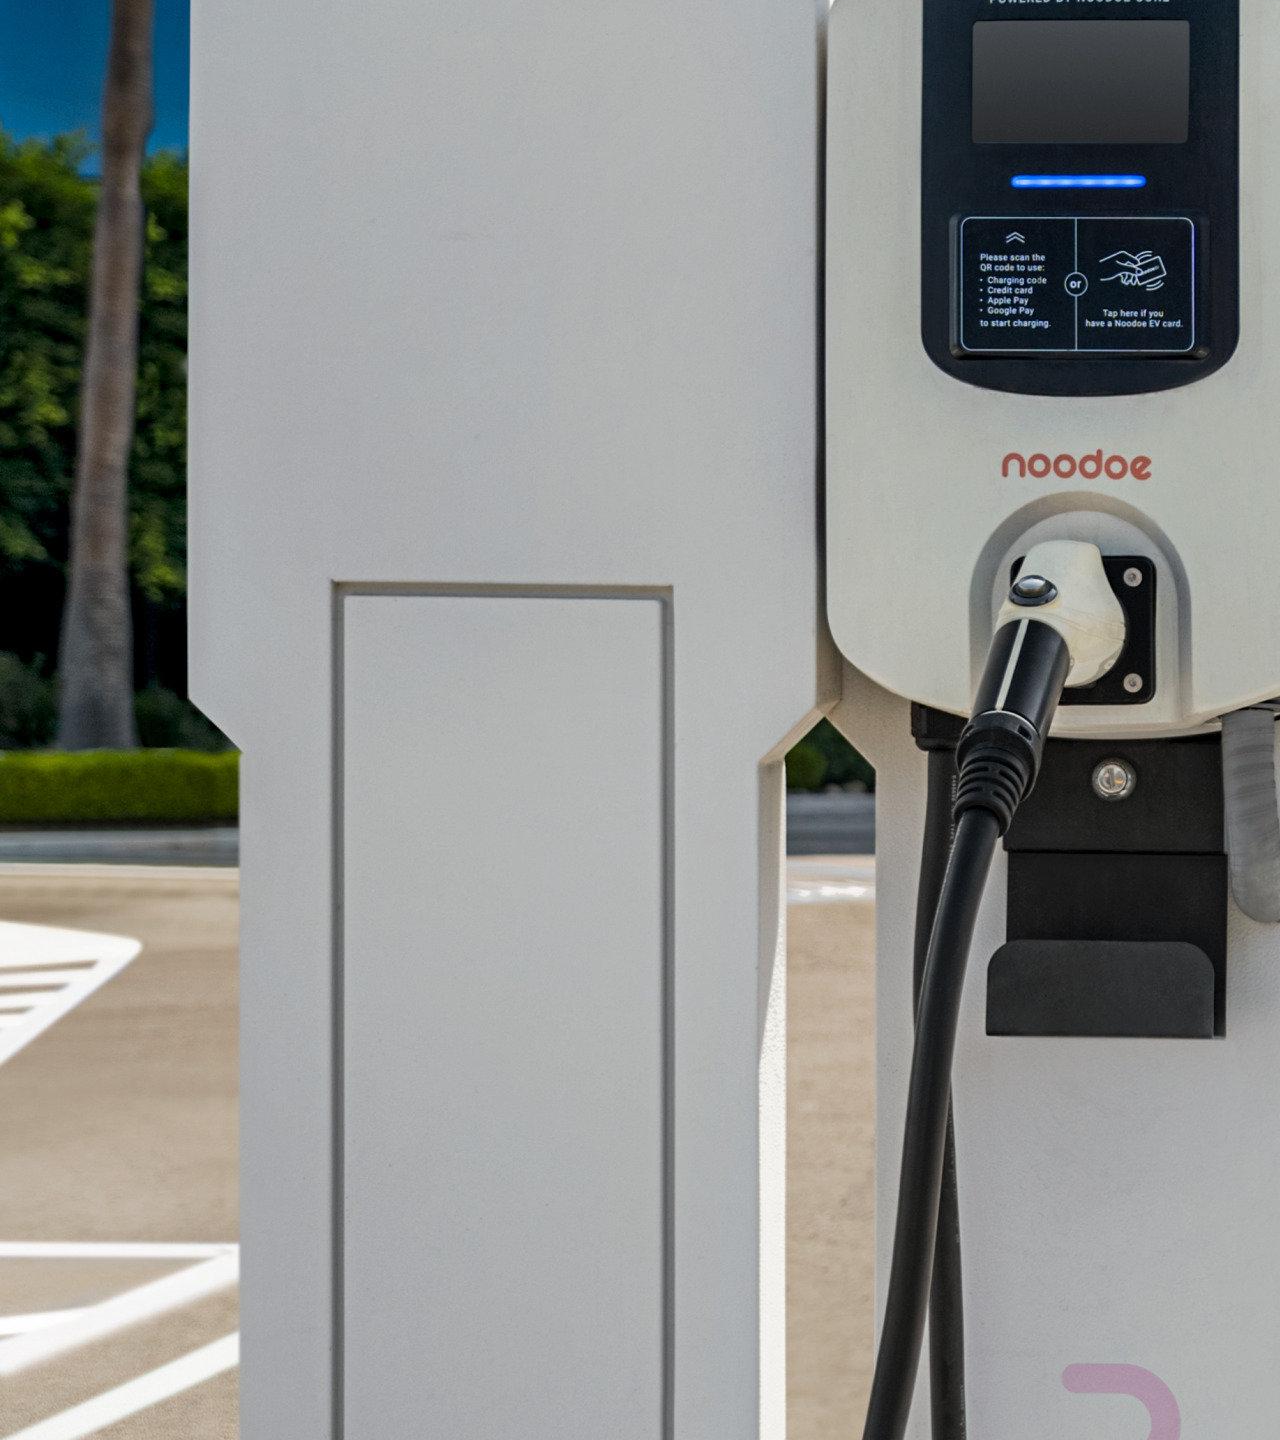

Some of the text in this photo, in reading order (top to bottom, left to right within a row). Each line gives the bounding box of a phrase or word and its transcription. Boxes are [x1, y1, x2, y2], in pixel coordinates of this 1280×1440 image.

[980, 264, 992, 272] QR
[987, 277, 1025, 285] Charging
[987, 286, 1033, 294] Credit card
[987, 296, 1028, 306] Apple Pay
[987, 306, 1035, 316] Google Pay
[1103, 309, 1164, 318] Tap here if you
[1012, 320, 1051, 329] charging.
[1085, 319, 1105, 327] have
[1114, 319, 1147, 327] Noodoe
[1162, 319, 1183, 328] card.
[1002, 449, 1152, 481] noodoe
